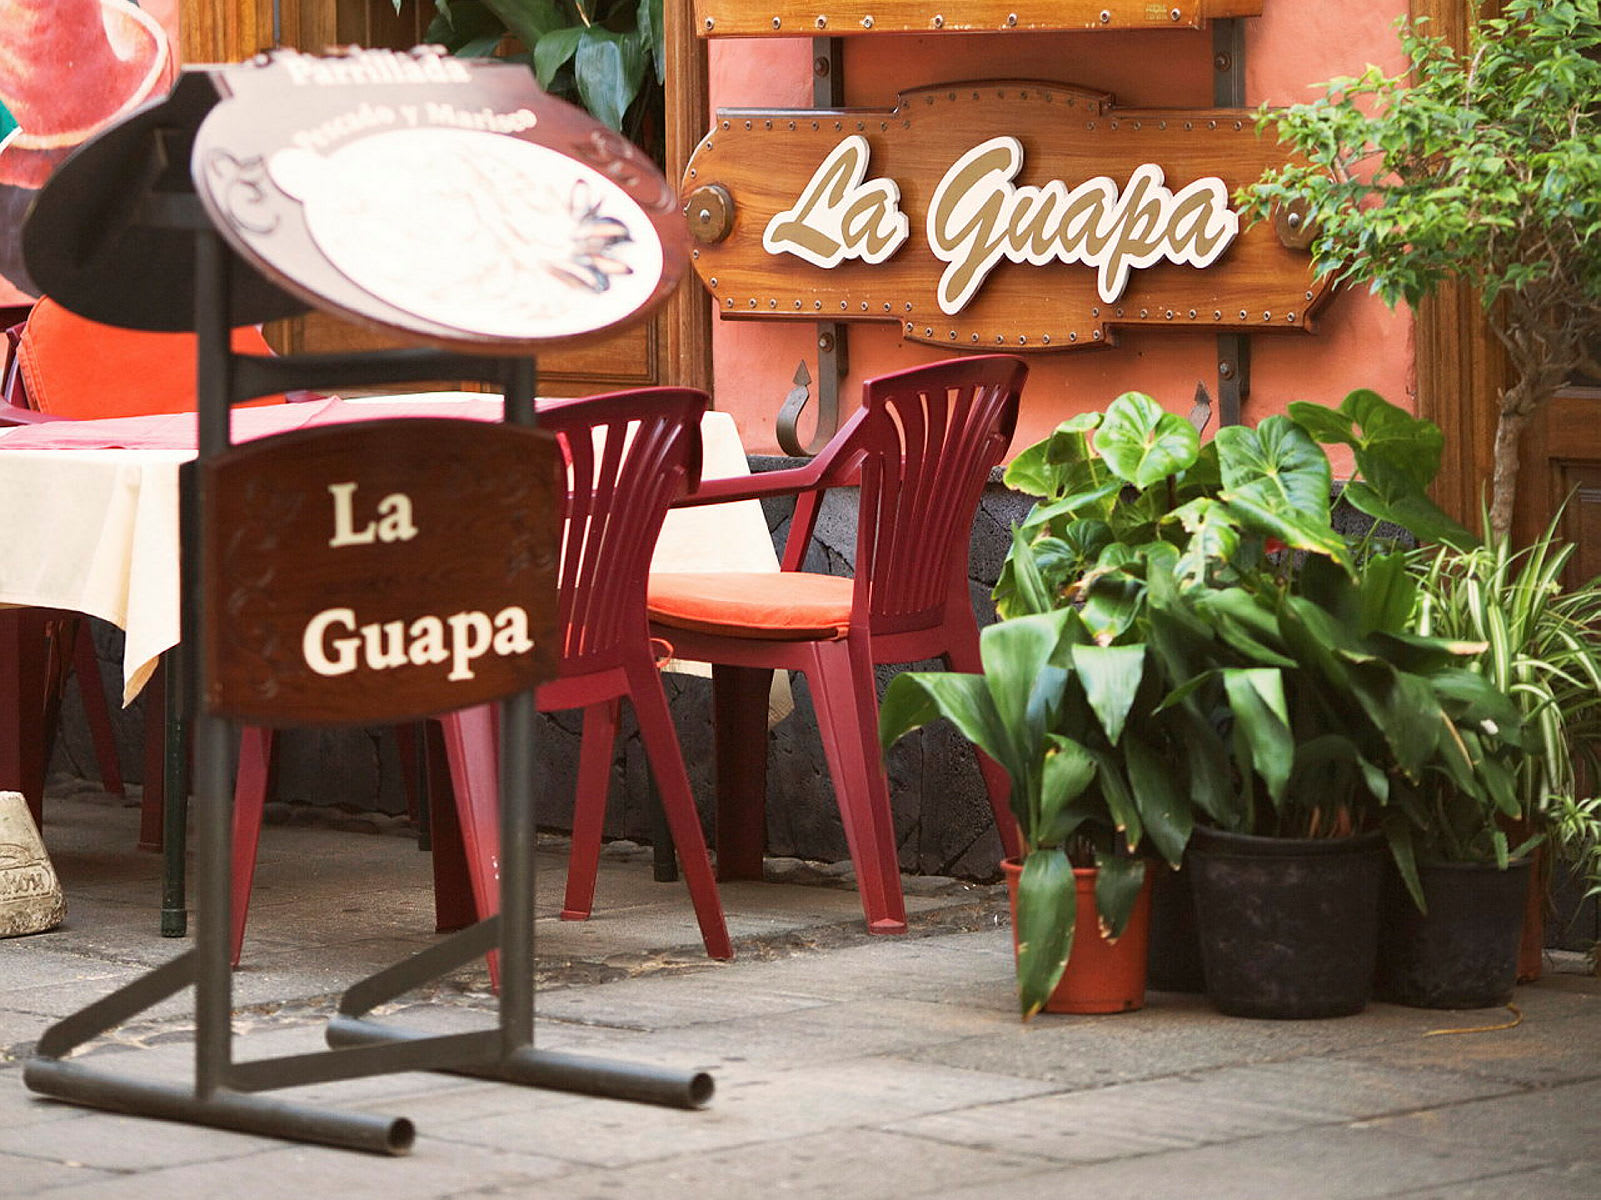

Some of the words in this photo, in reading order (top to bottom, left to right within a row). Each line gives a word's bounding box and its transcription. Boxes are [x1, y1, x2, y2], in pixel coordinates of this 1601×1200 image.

[763, 135, 909, 268] La
[927, 136, 1239, 315] Guapa
[329, 482, 418, 548] La
[303, 606, 534, 681] Guapa
